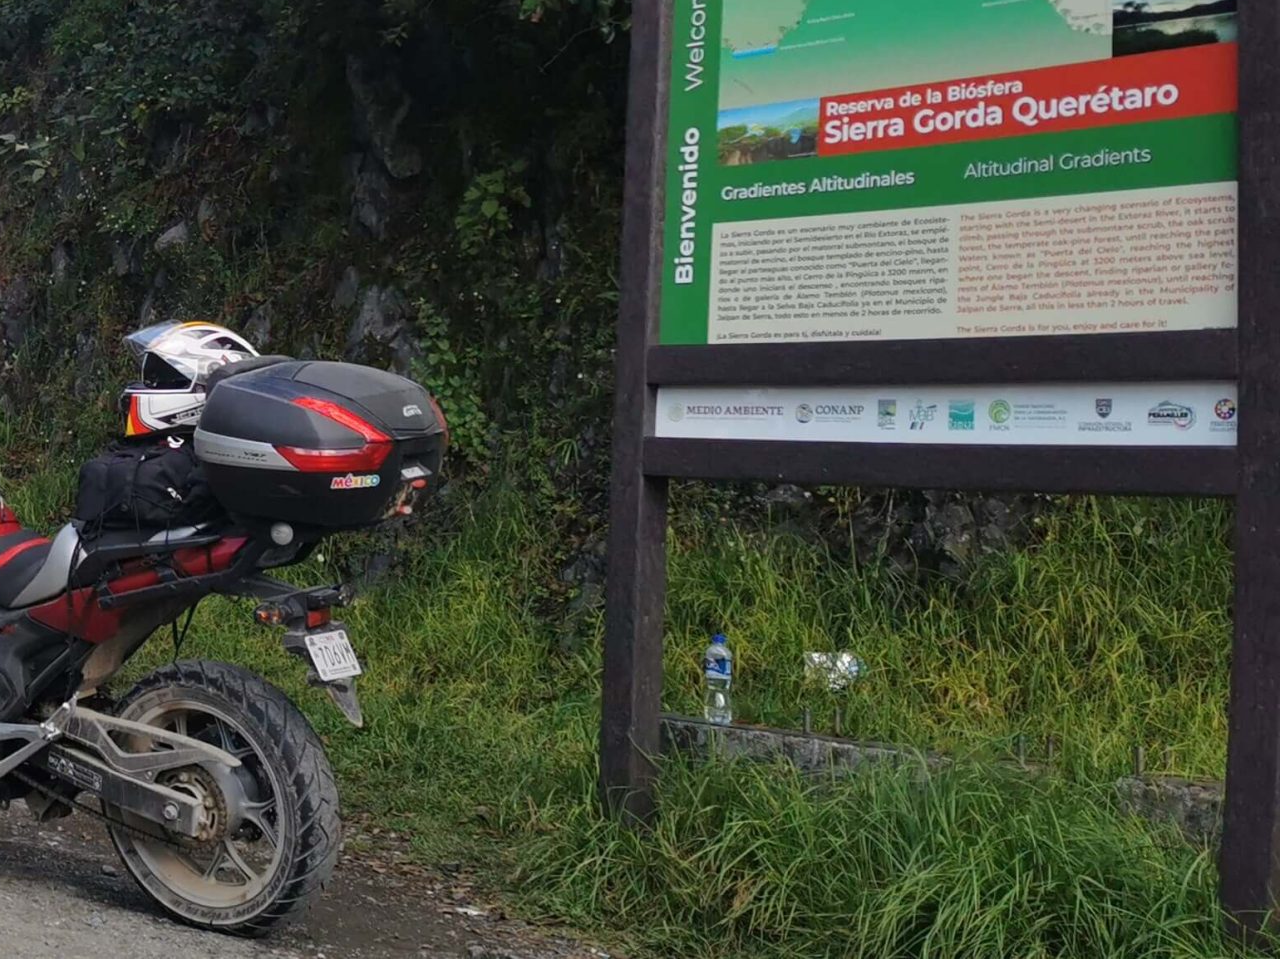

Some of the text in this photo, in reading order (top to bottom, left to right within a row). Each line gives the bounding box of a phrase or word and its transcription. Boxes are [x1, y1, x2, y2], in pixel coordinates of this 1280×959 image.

[824, 84, 1179, 144] Sierra Gorda Querétaro
[826, 80, 1023, 117] Reserva de la Biósfera
[963, 147, 1152, 179] Altitudinal Gradients
[721, 170, 915, 200] Gradientes Altitudinales
[674, 127, 700, 284] Bienvenido
[686, 406, 784, 416] MEDIO AMBIENTE
[815, 405, 864, 415] CONANP
